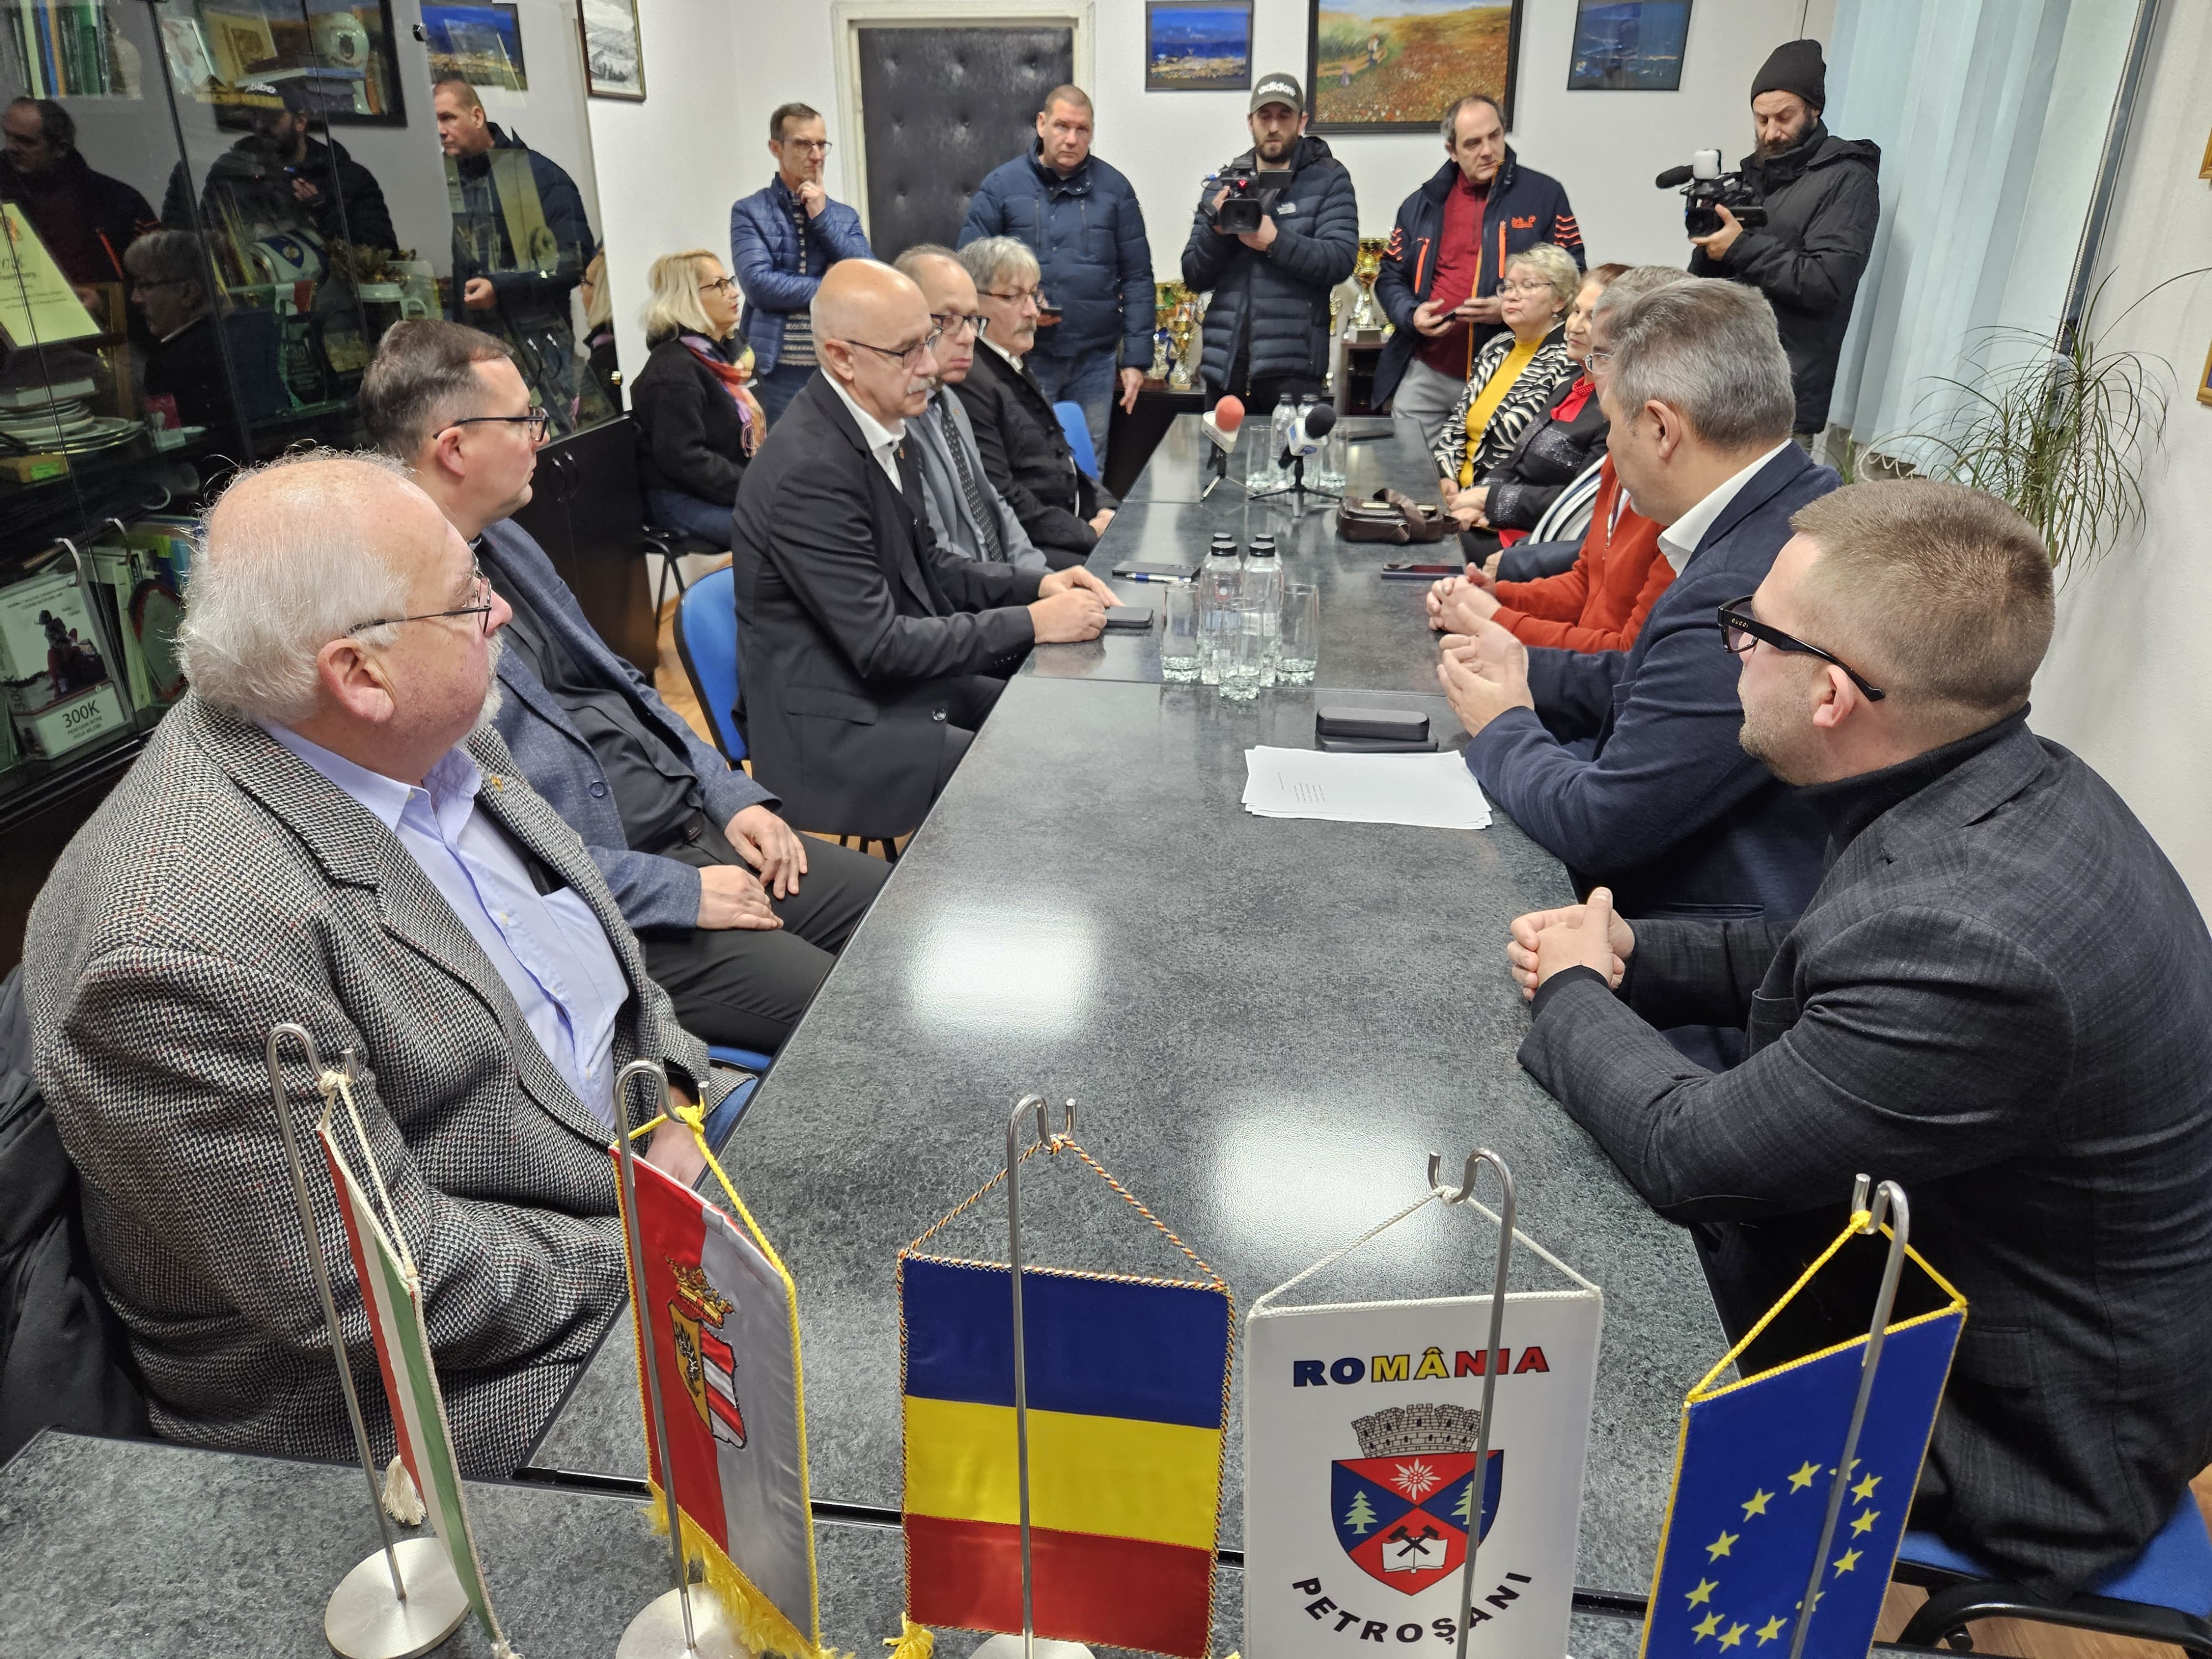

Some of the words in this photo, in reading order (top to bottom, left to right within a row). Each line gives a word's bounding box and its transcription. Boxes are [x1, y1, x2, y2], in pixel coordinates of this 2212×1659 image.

[1731, 618, 1749, 629] GUCCI
[62, 700, 100, 728] 300K
[1293, 1346, 1550, 1387] ROMÂNIA
